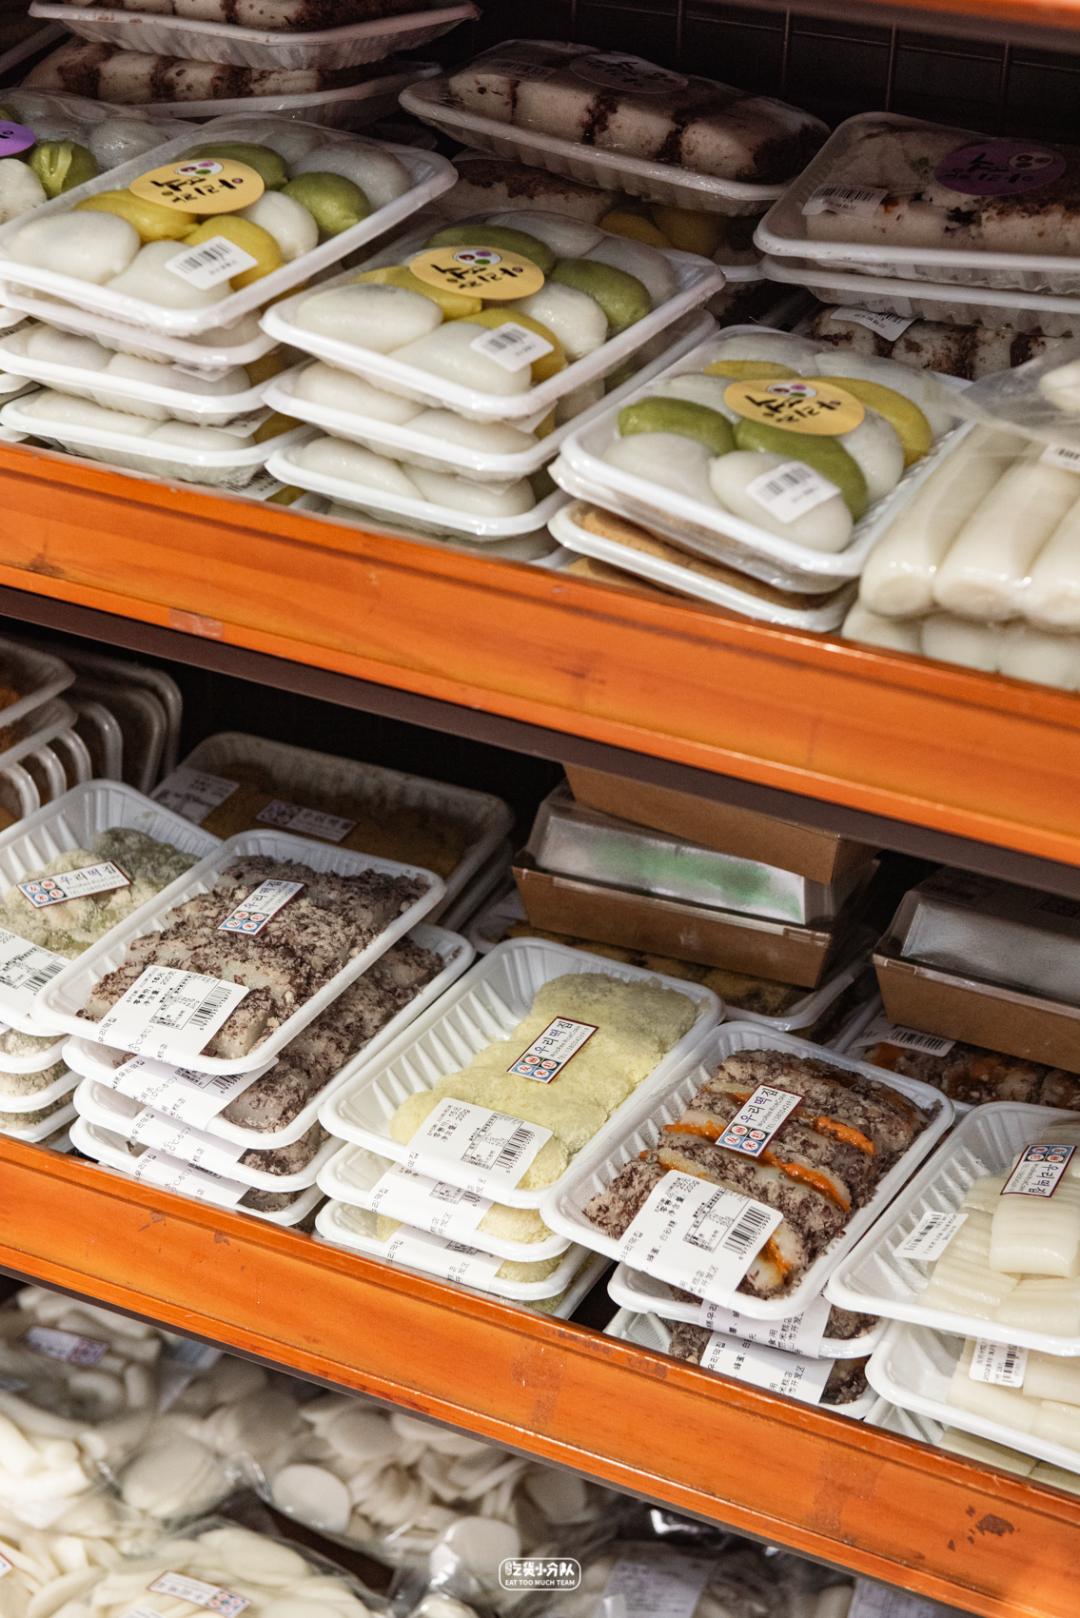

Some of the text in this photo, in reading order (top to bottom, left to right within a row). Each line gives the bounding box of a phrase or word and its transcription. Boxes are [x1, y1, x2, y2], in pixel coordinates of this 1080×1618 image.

[534, 1021, 573, 1054] 우리떡집
[740, 1087, 778, 1124] 우리떡집
[1028, 1164, 1059, 1194] 우리떡집
